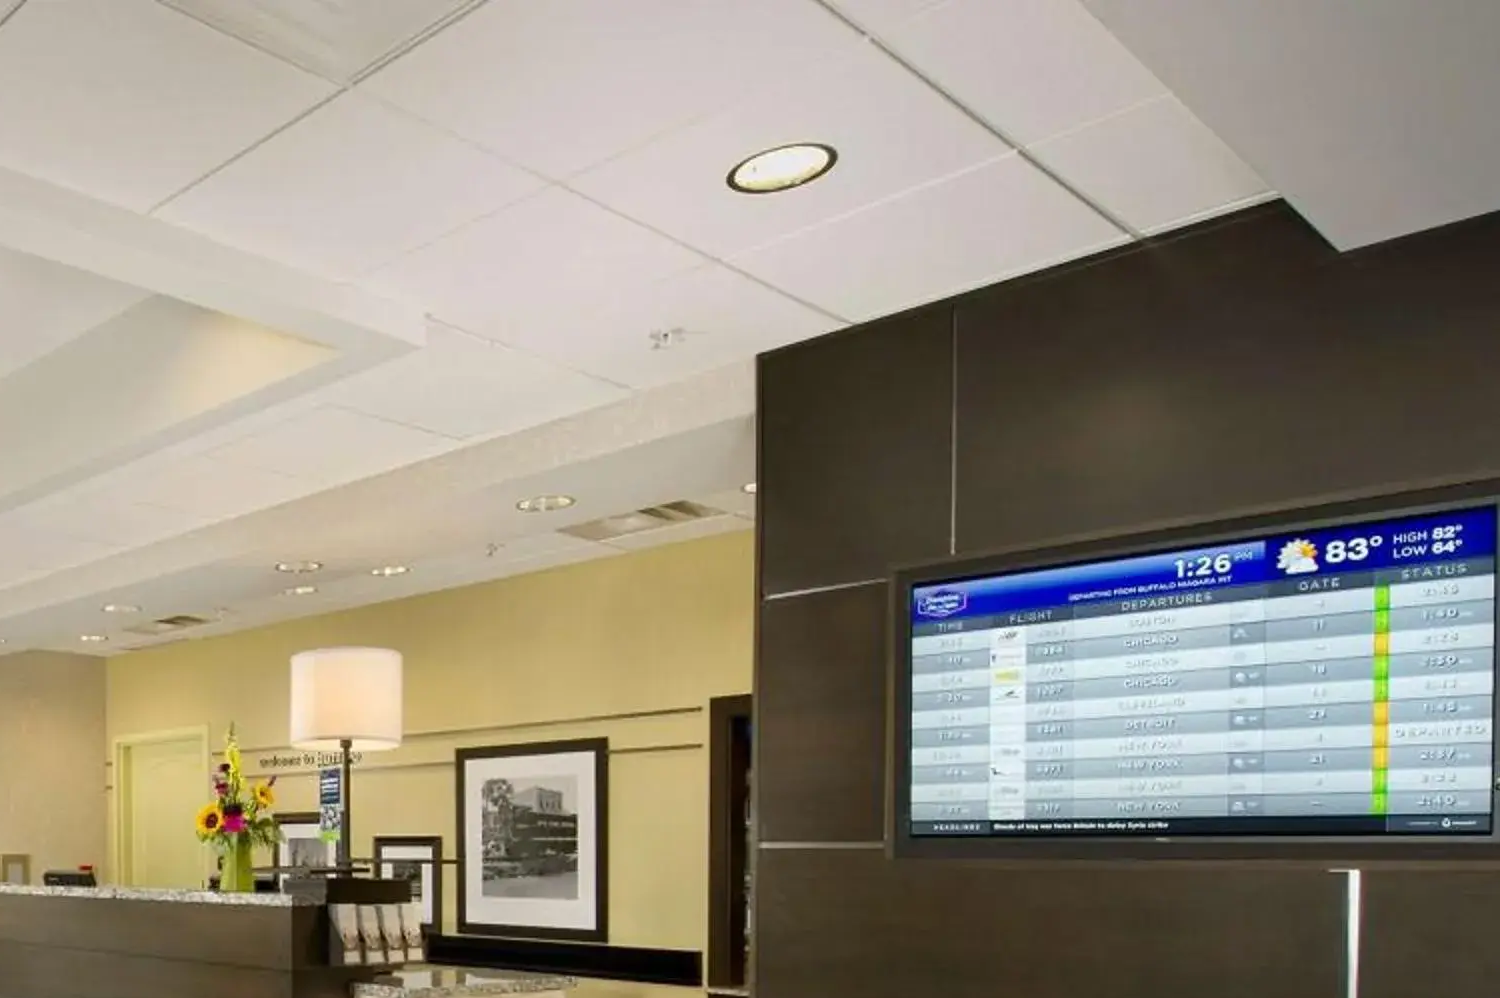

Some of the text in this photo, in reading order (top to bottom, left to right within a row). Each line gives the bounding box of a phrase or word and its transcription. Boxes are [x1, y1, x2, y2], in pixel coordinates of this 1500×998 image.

[1393, 532, 1428, 545] HIGH
[1393, 545, 1427, 559] LOW
[1175, 553, 1232, 579] 1:26
[1401, 564, 1469, 580] STATUS
[1299, 578, 1340, 591] GATE
[1121, 592, 1213, 611] DEPARTURES
[1009, 610, 1053, 624] FLIGHT
